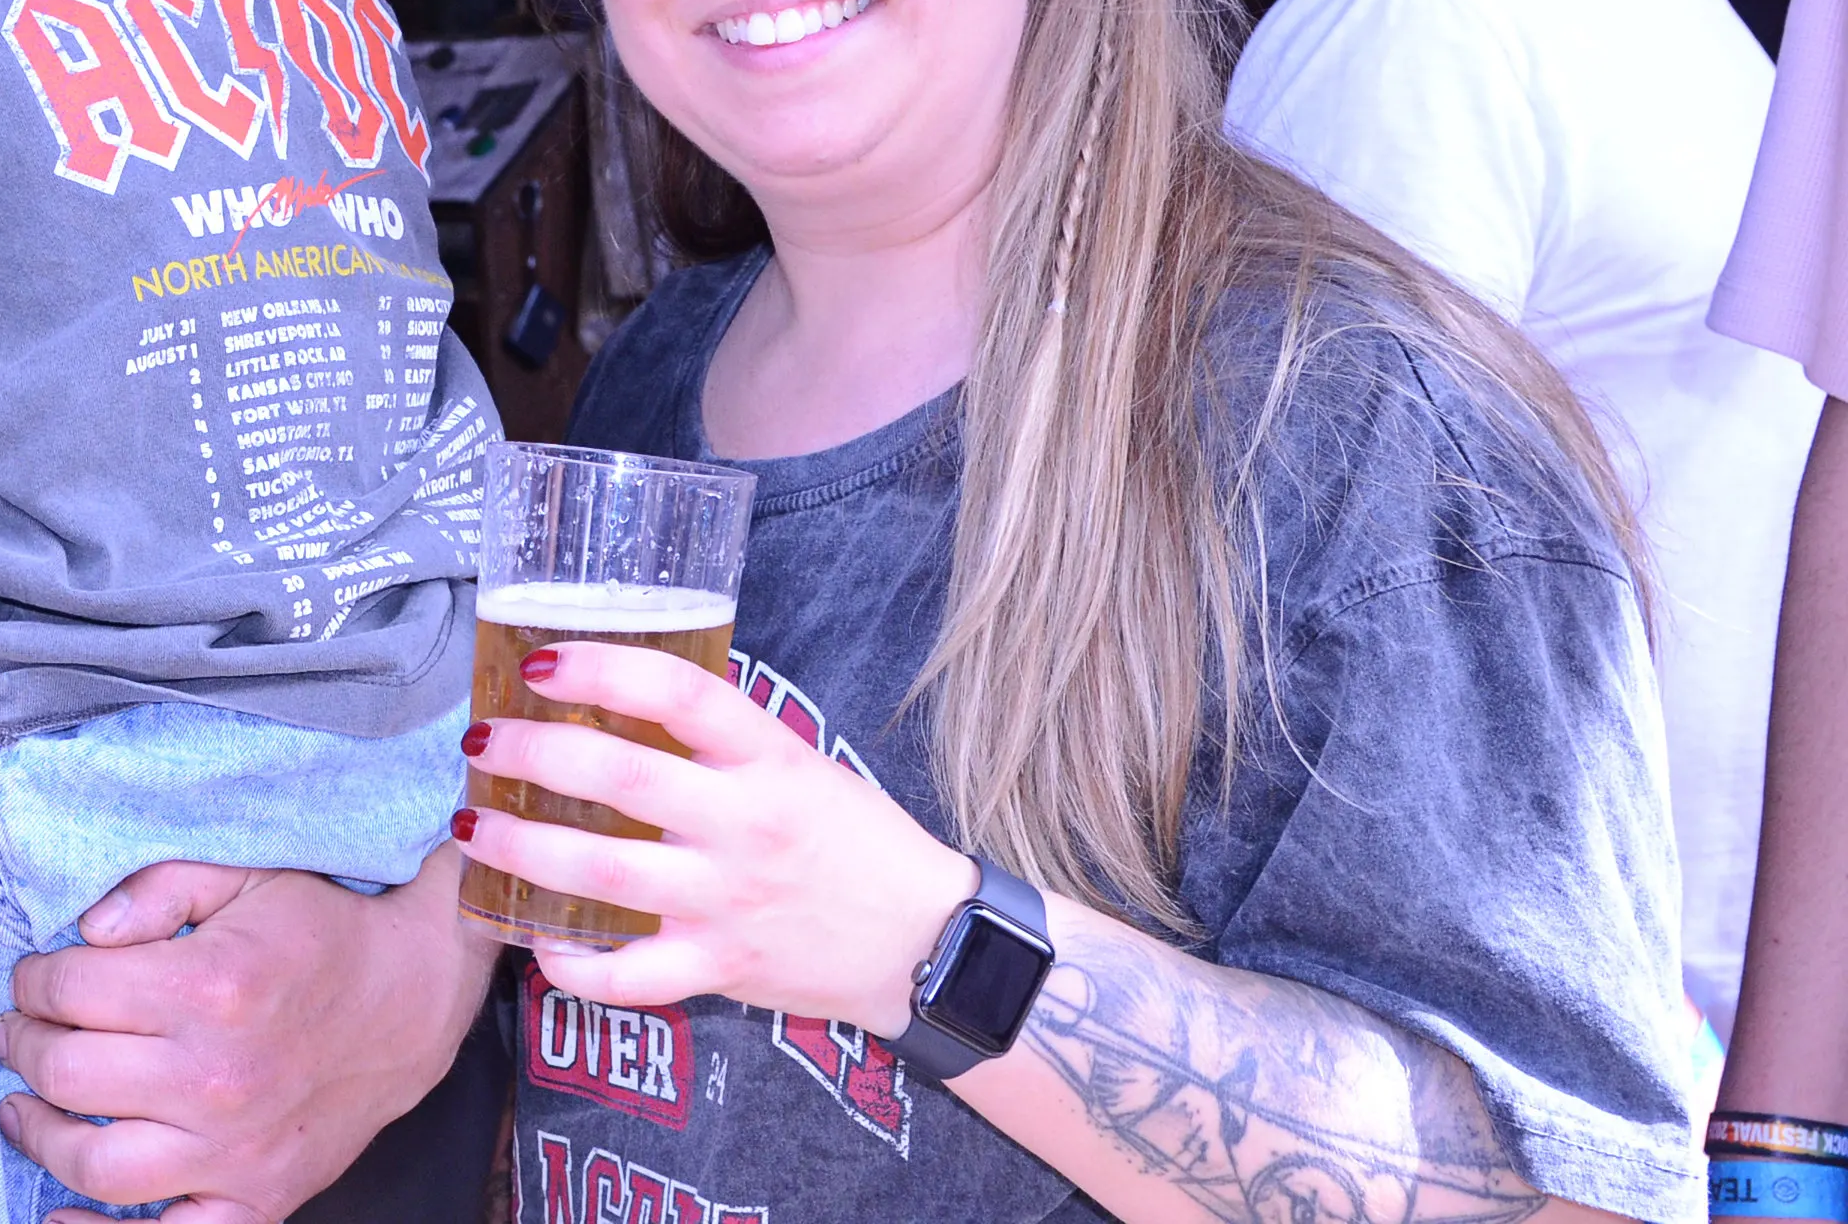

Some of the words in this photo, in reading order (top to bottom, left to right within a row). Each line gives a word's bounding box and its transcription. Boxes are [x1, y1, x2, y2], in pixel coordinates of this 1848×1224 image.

[171, 182, 295, 238] WHO
[326, 191, 406, 241] WHO
[131, 251, 248, 302] NORTH
[254, 243, 385, 280] AMERICAN
[139, 323, 174, 346] JULY
[180, 318, 197, 337] 31
[220, 306, 258, 327] NEW
[126, 344, 188, 376] AUGUST
[190, 343, 198, 359] 1
[189, 367, 201, 385] 2
[225, 353, 281, 378] LITTLE
[191, 393, 203, 410] 3
[227, 374, 302, 403] KANSAS
[194, 419, 208, 434] 4
[231, 403, 281, 425] FORT
[200, 442, 213, 459] 5
[205, 467, 218, 484] 6
[243, 452, 281, 476] SAN
[211, 491, 221, 508] 7
[213, 516, 225, 533] 9
[254, 522, 290, 541] LAS
[281, 575, 305, 593] 20
[293, 598, 313, 619] 22
[540, 989, 679, 1103] OVER
[1733, 1120, 1819, 1152] FESTIVAL
